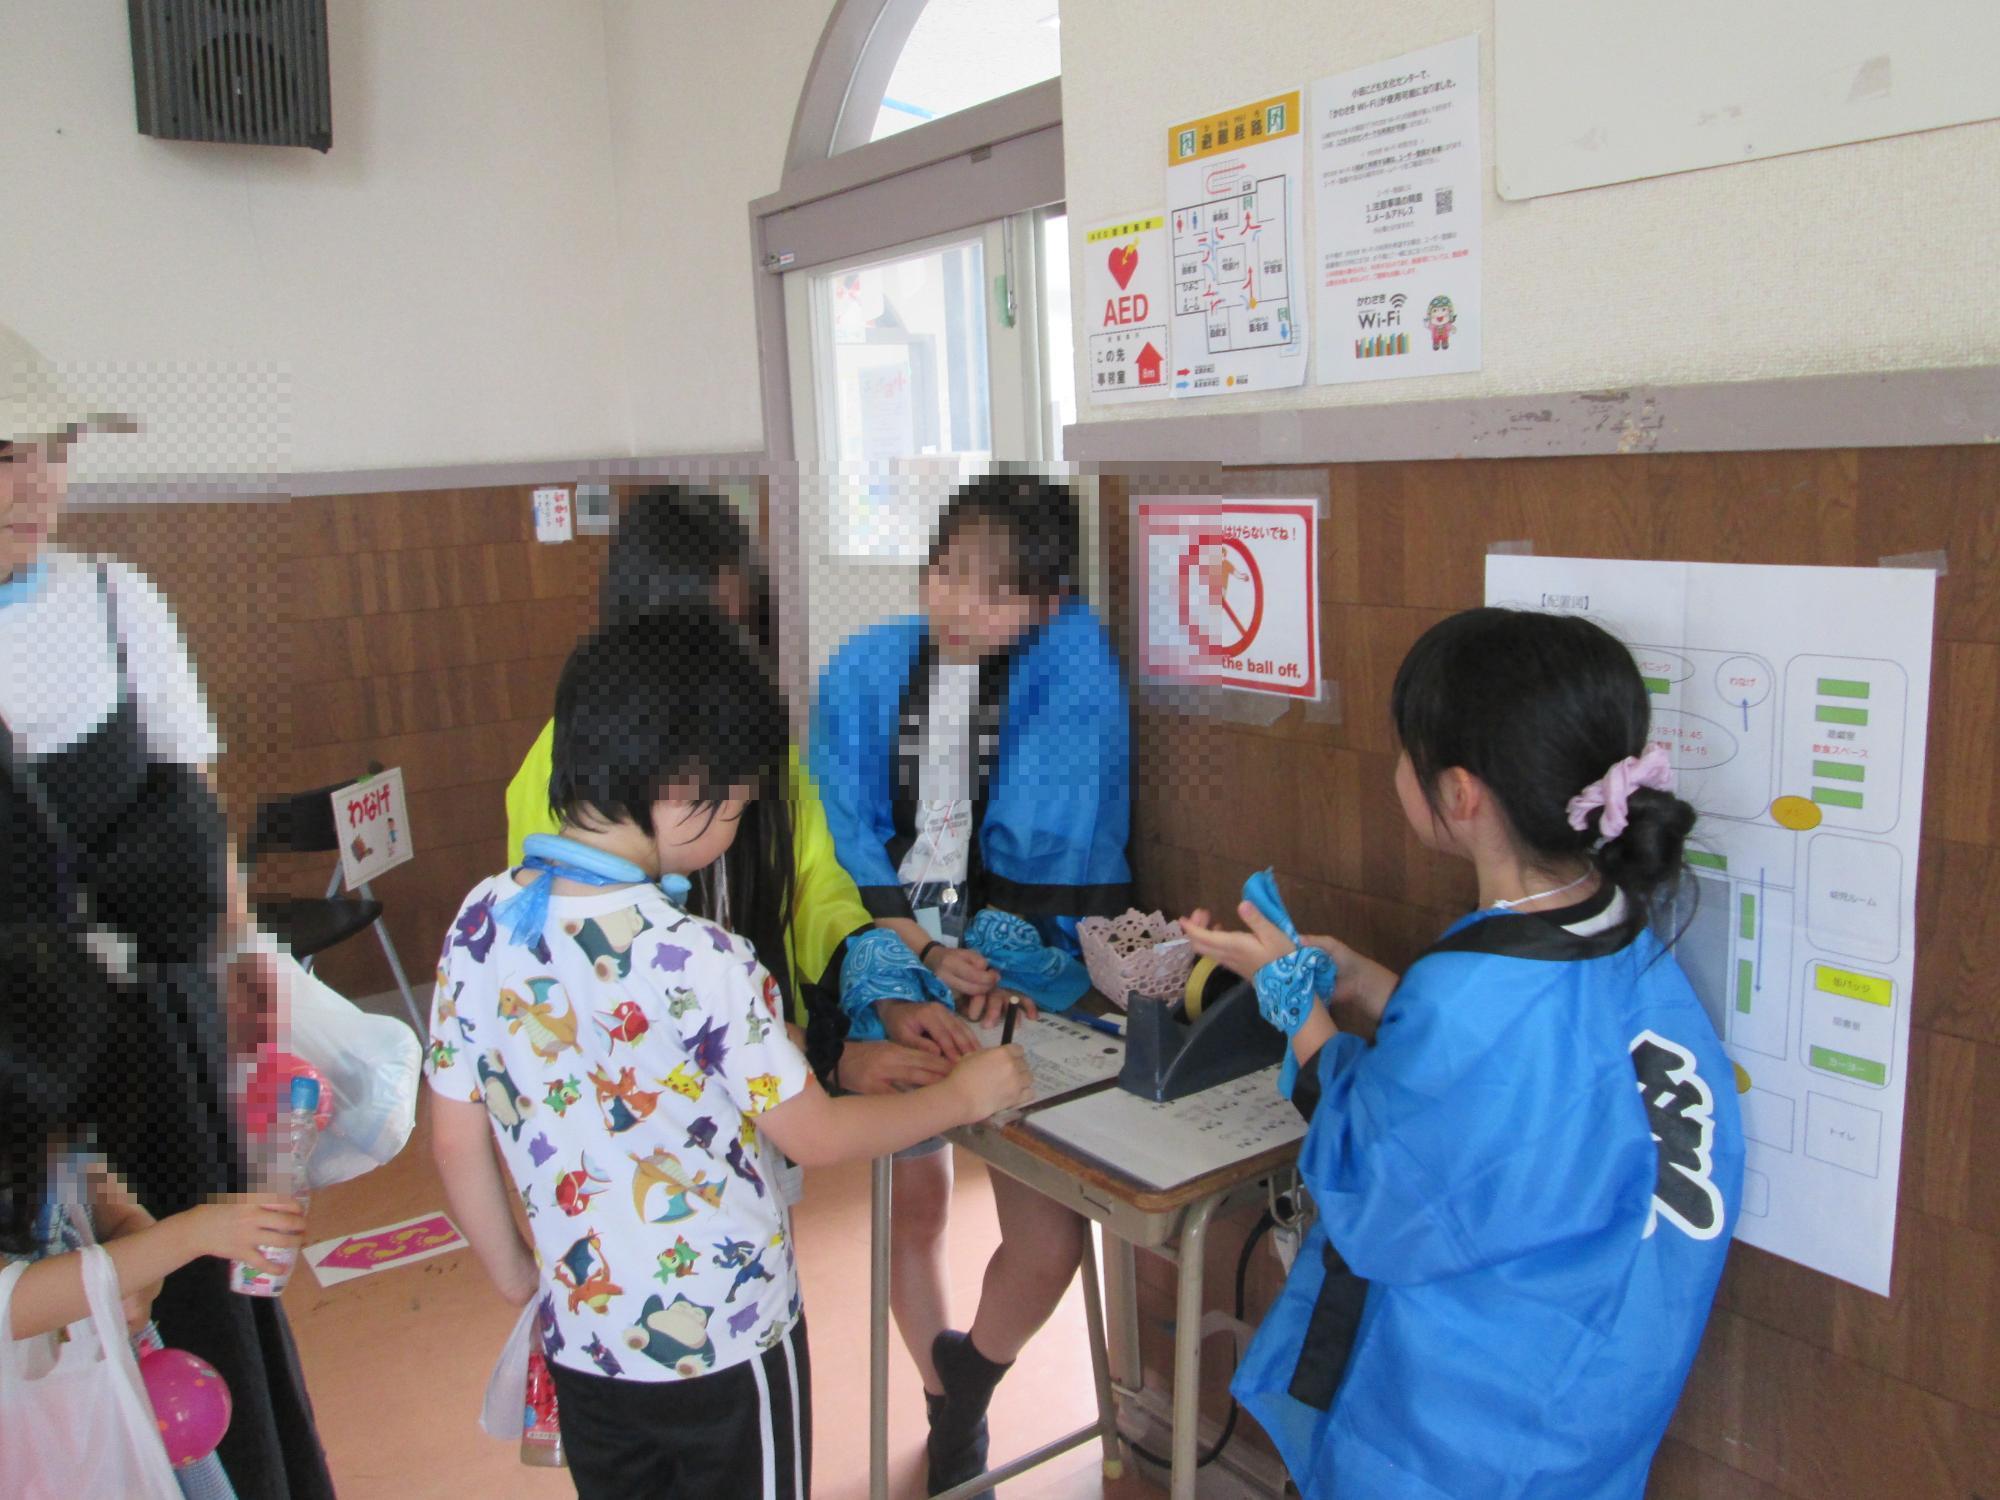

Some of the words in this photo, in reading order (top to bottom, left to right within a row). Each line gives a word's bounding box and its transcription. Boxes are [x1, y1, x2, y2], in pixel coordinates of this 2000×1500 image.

[1103, 293, 1149, 327] AED
[1358, 310, 1401, 329] Wi-Fi
[1097, 348, 1126, 364] この先
[1222, 525, 1297, 542] はけらないでね！
[1222, 657, 1243, 671] the
[1247, 658, 1273, 675] ball
[1278, 662, 1302, 679] off.
